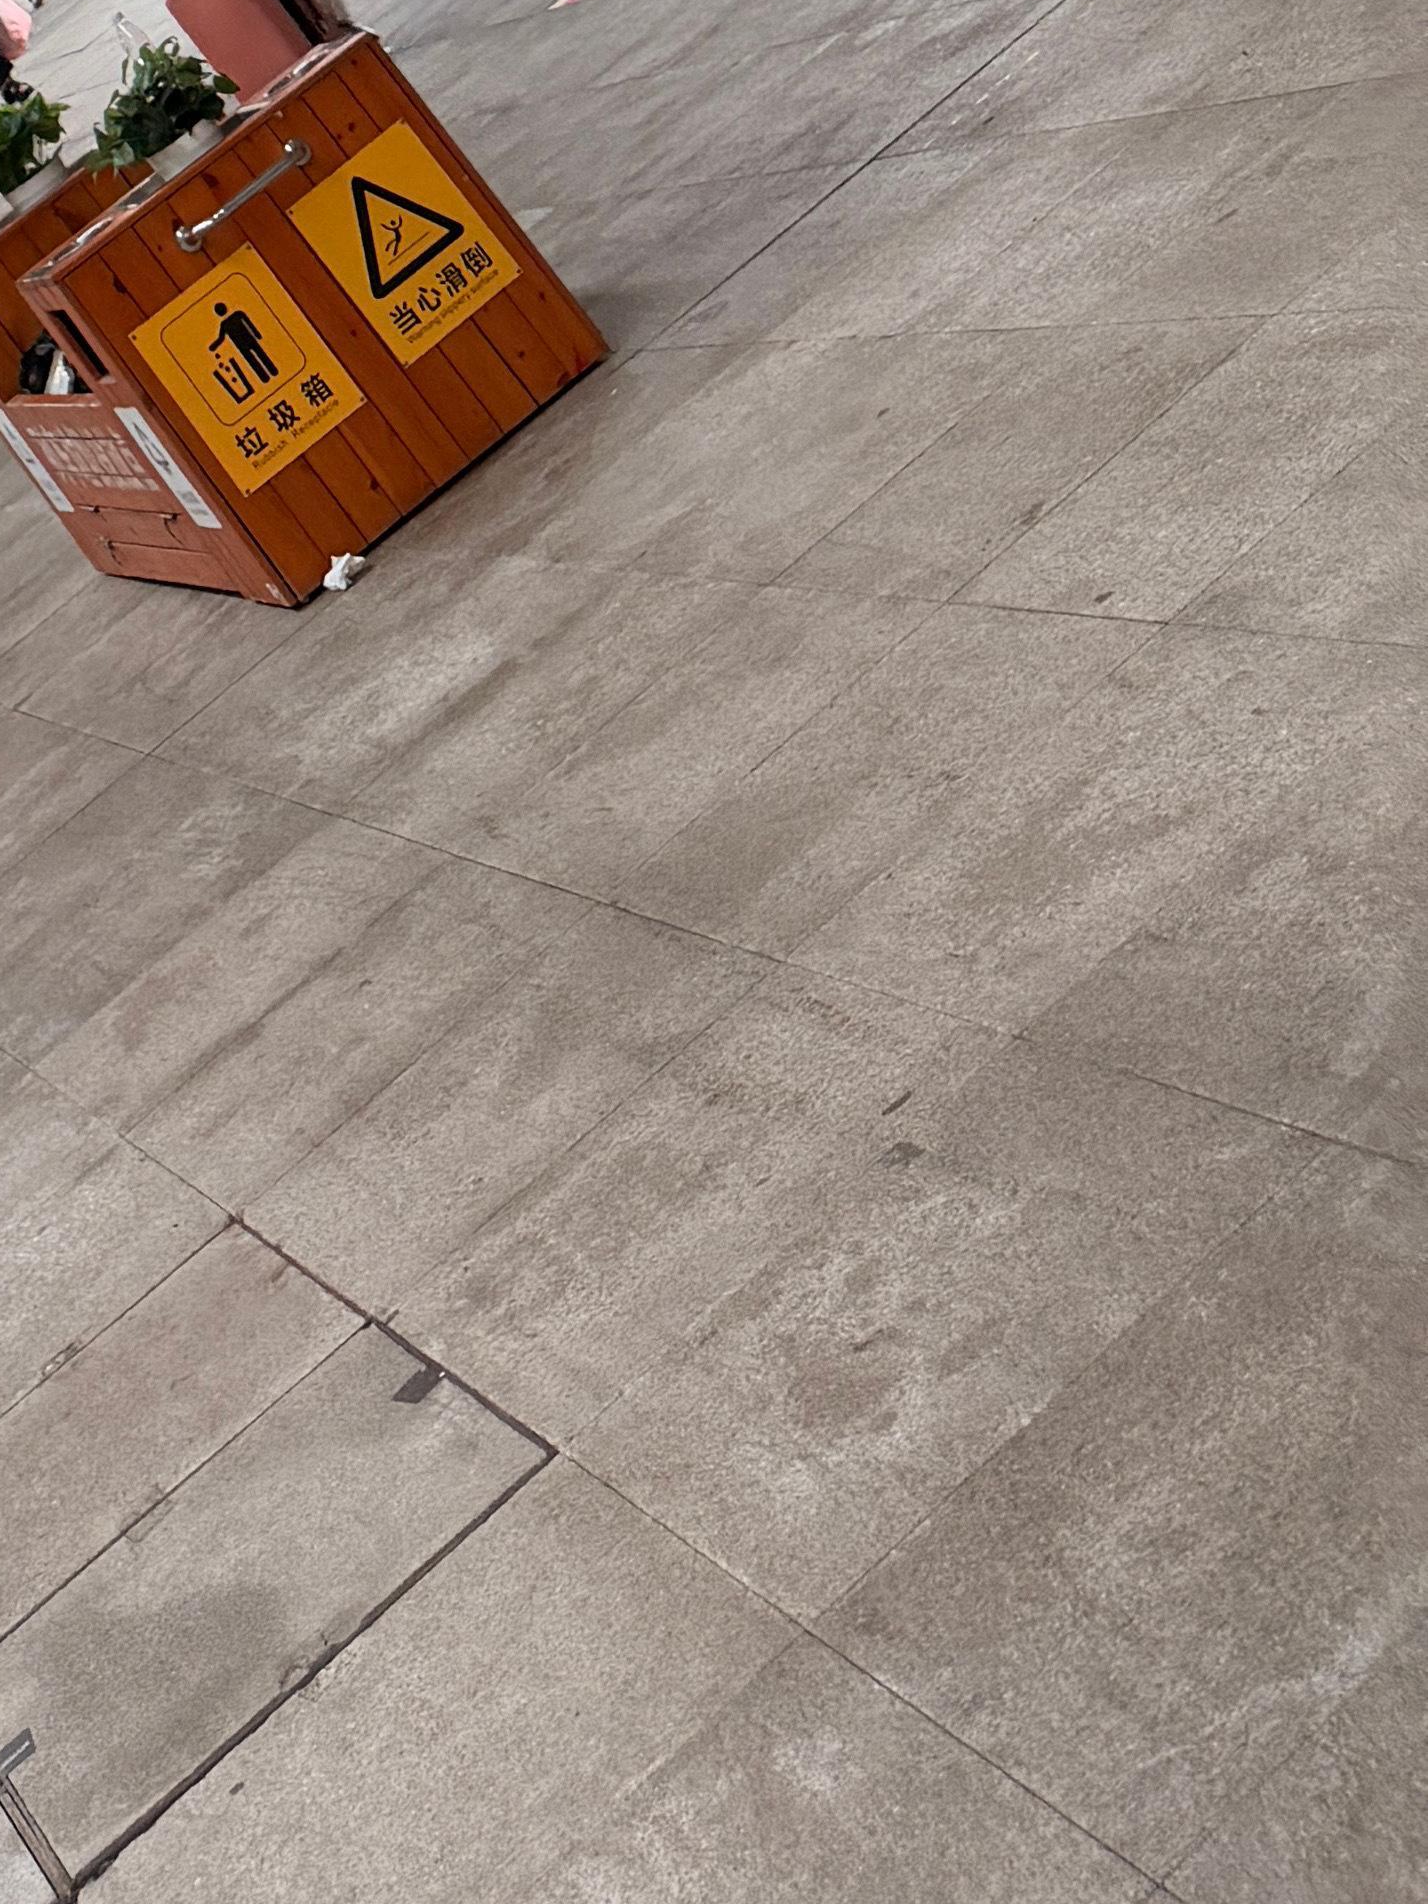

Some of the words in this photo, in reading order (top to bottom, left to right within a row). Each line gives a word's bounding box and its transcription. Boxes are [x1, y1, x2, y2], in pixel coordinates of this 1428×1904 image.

[389, 241, 493, 335] 当心滑倒
[235, 372, 334, 458] 垃圾箱
